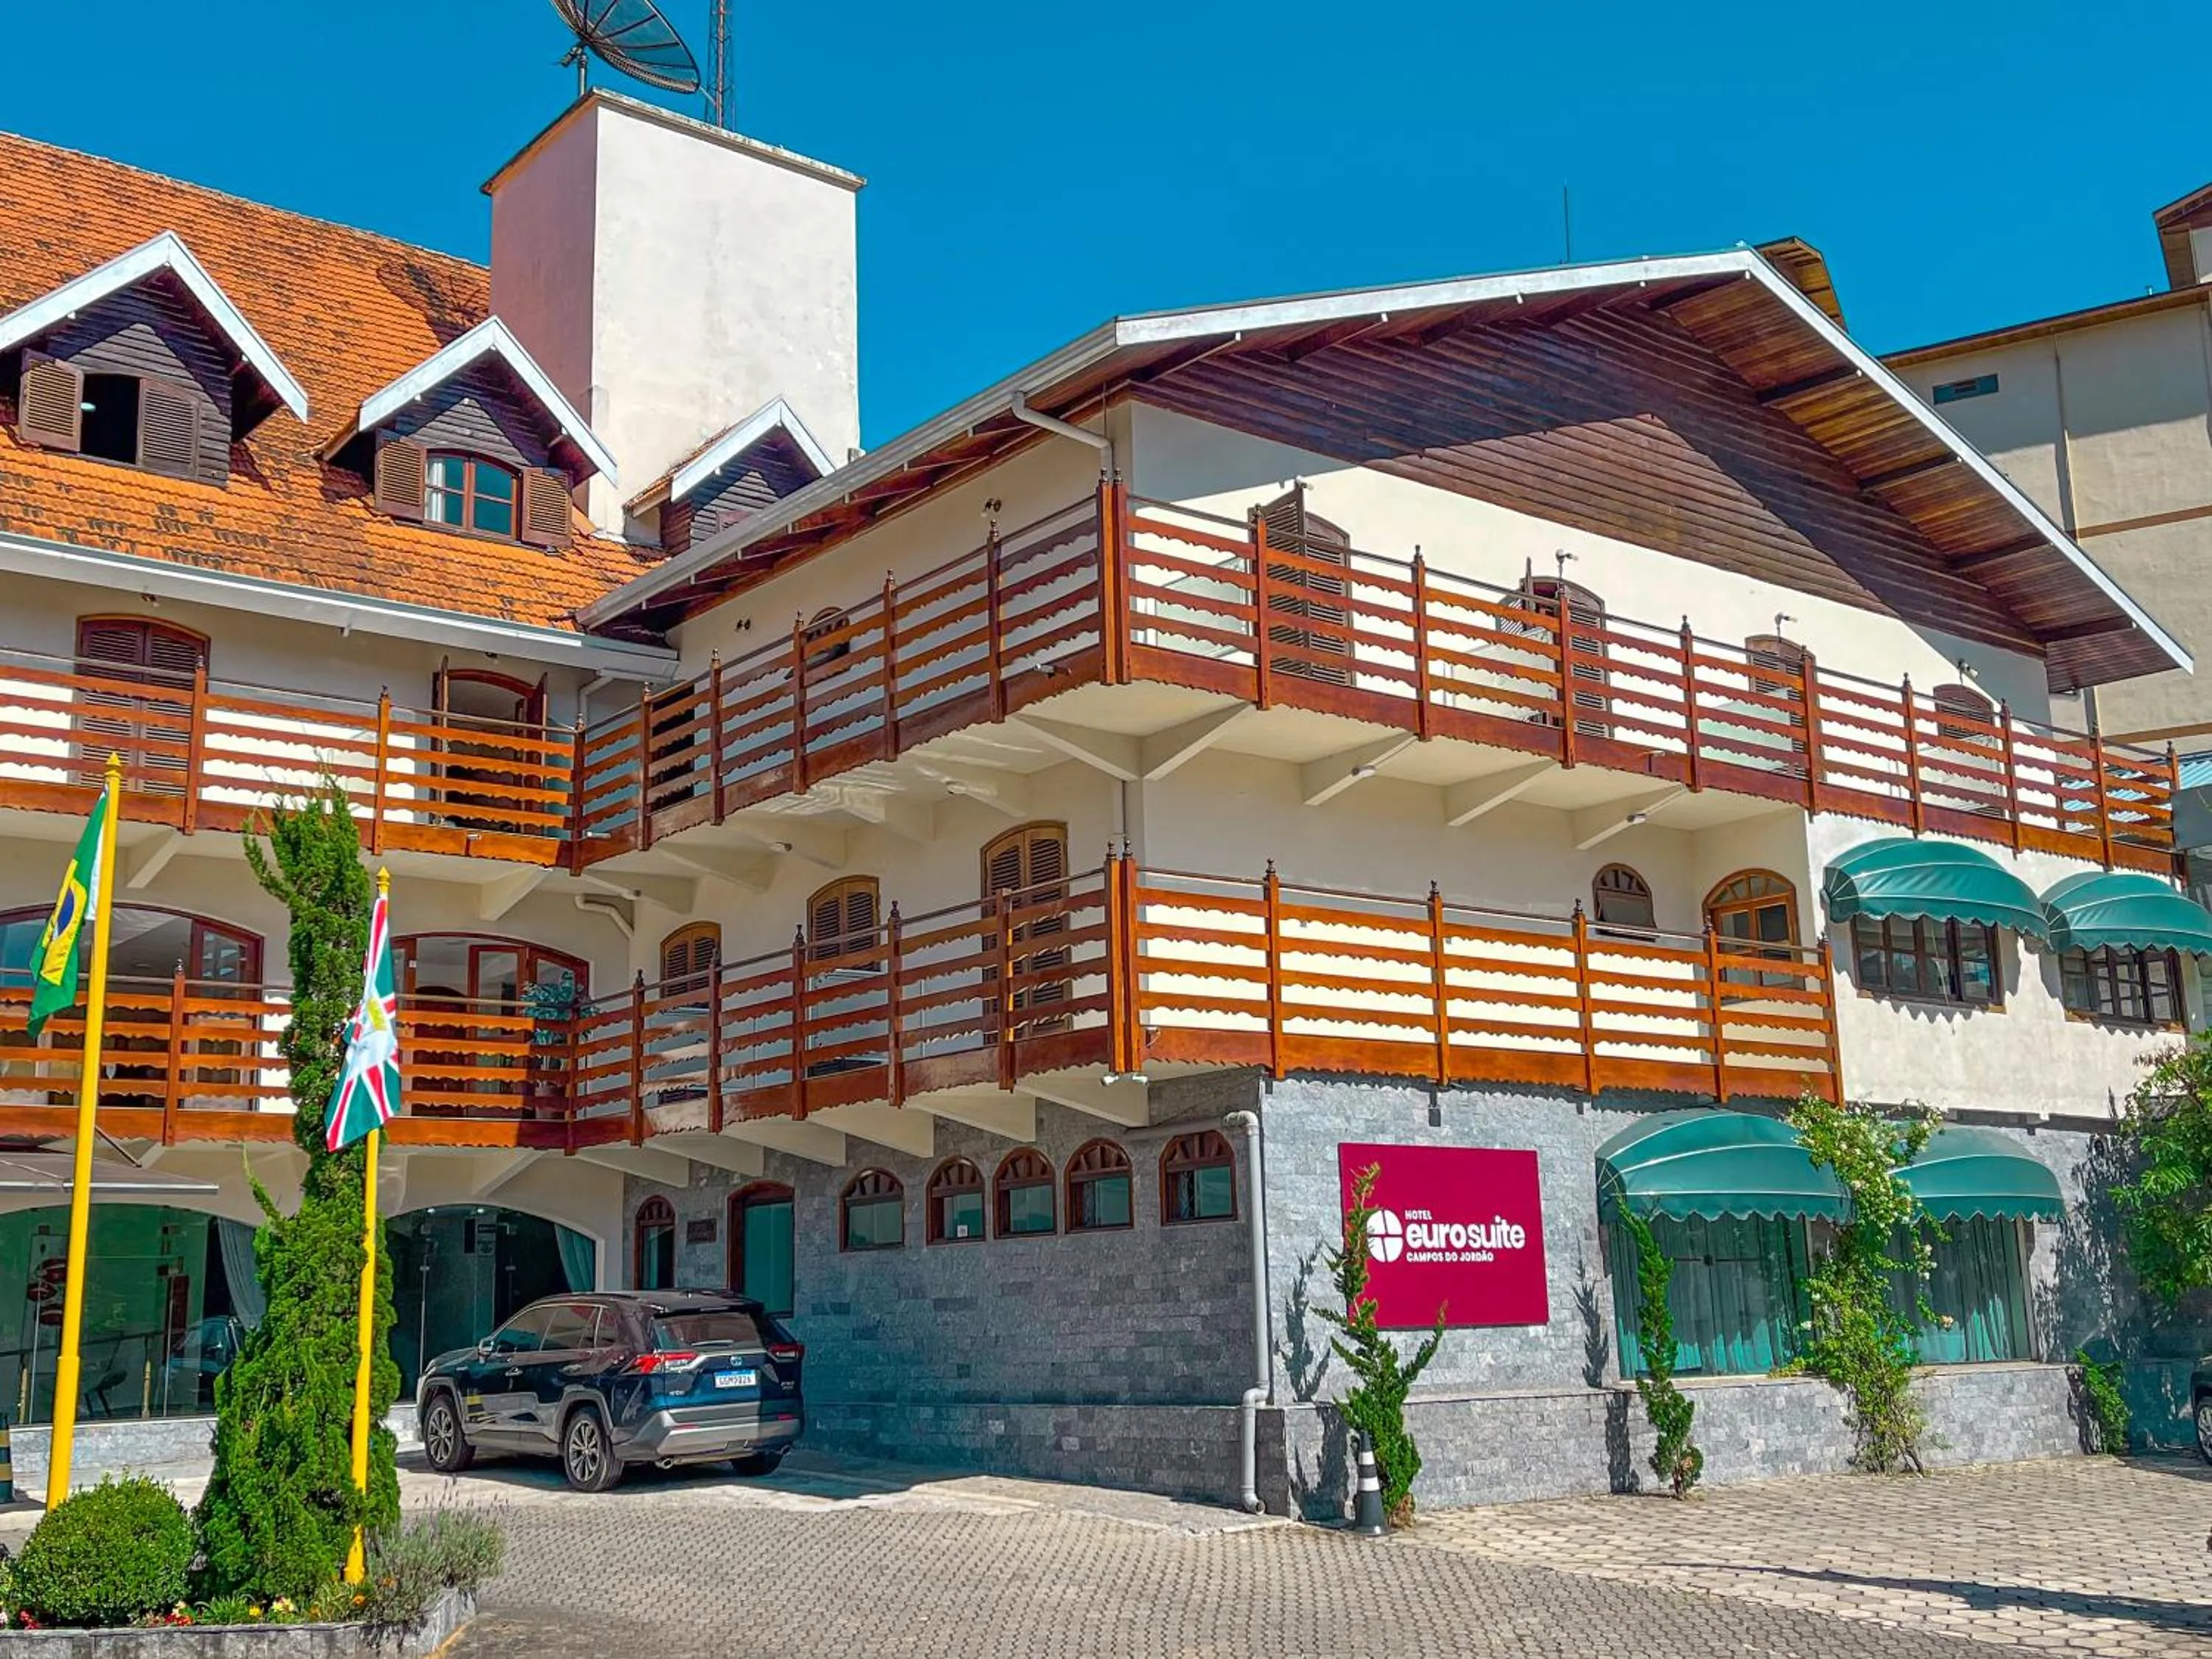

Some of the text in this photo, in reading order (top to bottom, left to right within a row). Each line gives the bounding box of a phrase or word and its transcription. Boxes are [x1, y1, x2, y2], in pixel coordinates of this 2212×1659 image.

[1405, 1210, 1432, 1220] HOTEL
[1406, 1215, 1526, 1248] eurosuite
[1406, 1251, 1494, 1262] CAMPOS DO JORDÃO
